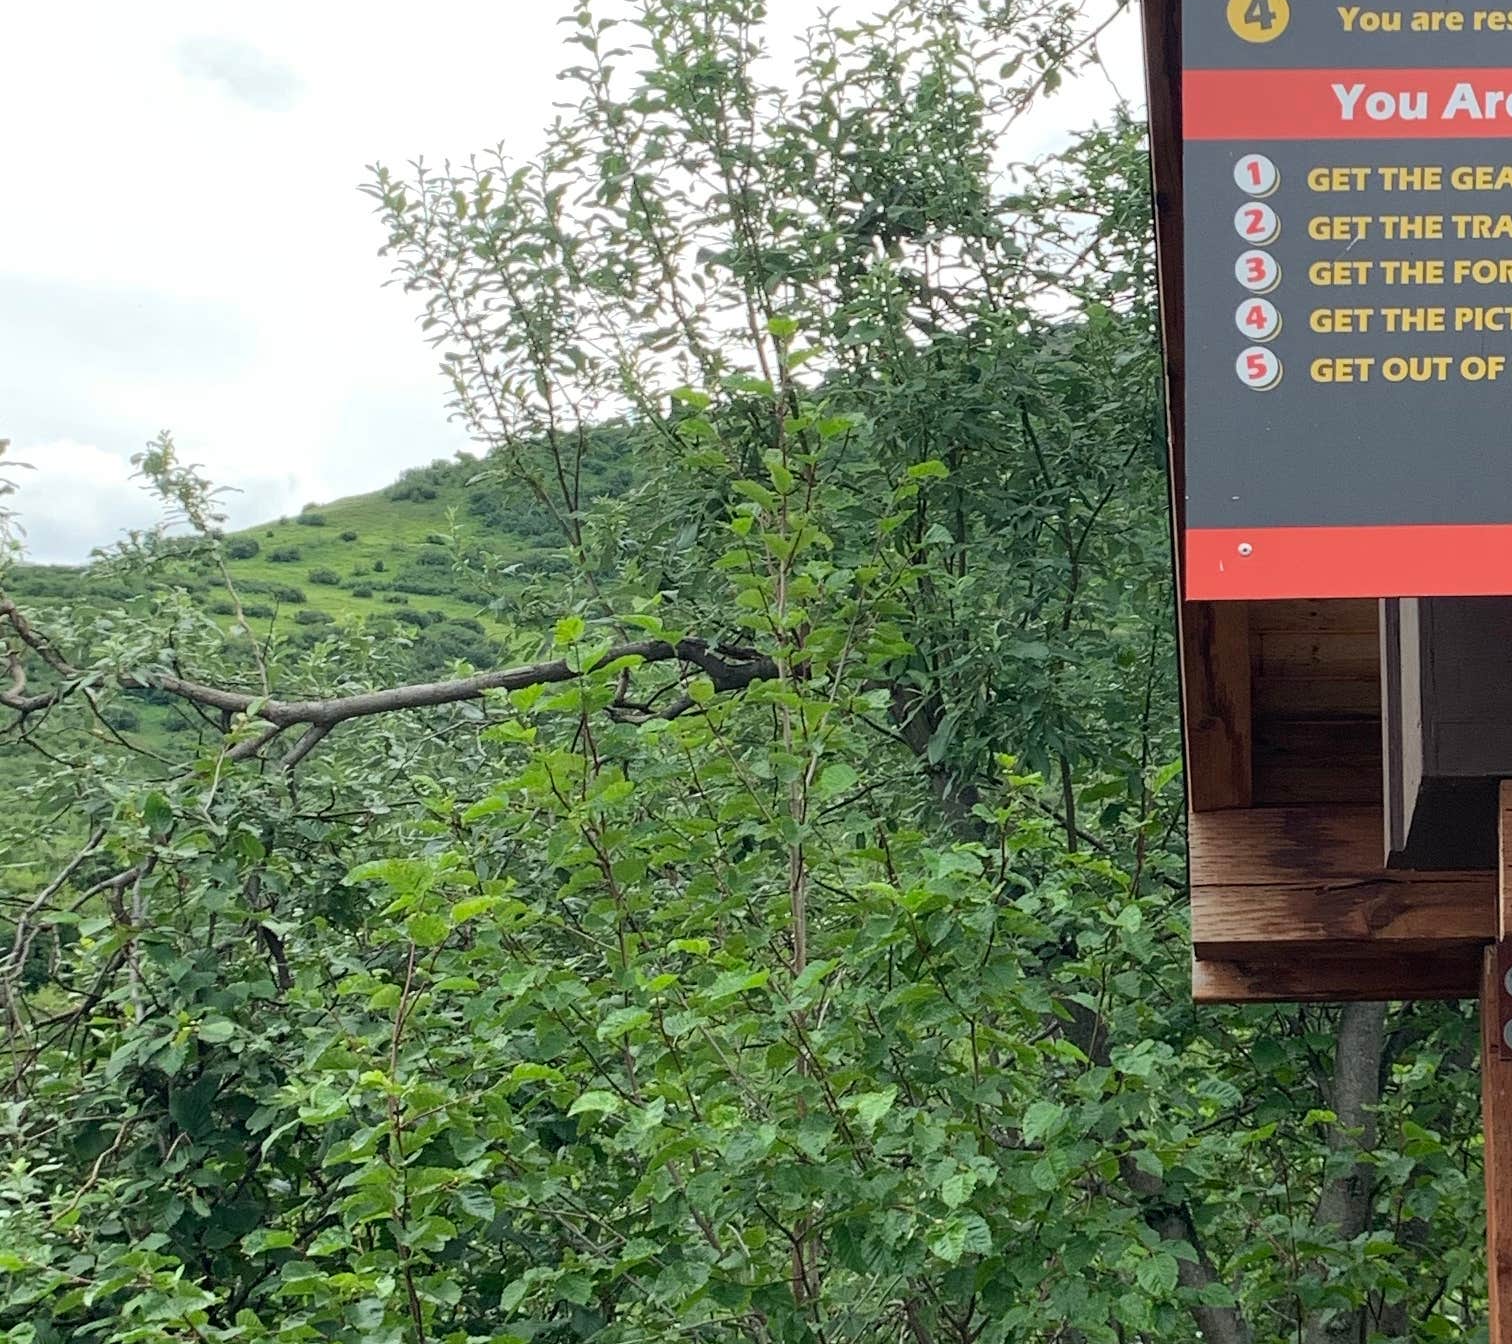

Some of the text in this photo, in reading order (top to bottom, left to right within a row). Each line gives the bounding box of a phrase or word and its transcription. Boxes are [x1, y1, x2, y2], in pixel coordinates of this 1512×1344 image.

[1338, 7, 1401, 31] You
[1411, 12, 1464, 30] are
[1332, 84, 1428, 120] You
[1308, 168, 1371, 191] GET
[1378, 168, 1441, 190] THE
[1309, 217, 1373, 240] GET
[1379, 216, 1443, 239] THE
[1309, 262, 1372, 285] GET
[1380, 261, 1444, 284] THE
[1311, 358, 1374, 382] GET
[1383, 358, 1452, 381] OUT
[1461, 357, 1505, 380] OF
